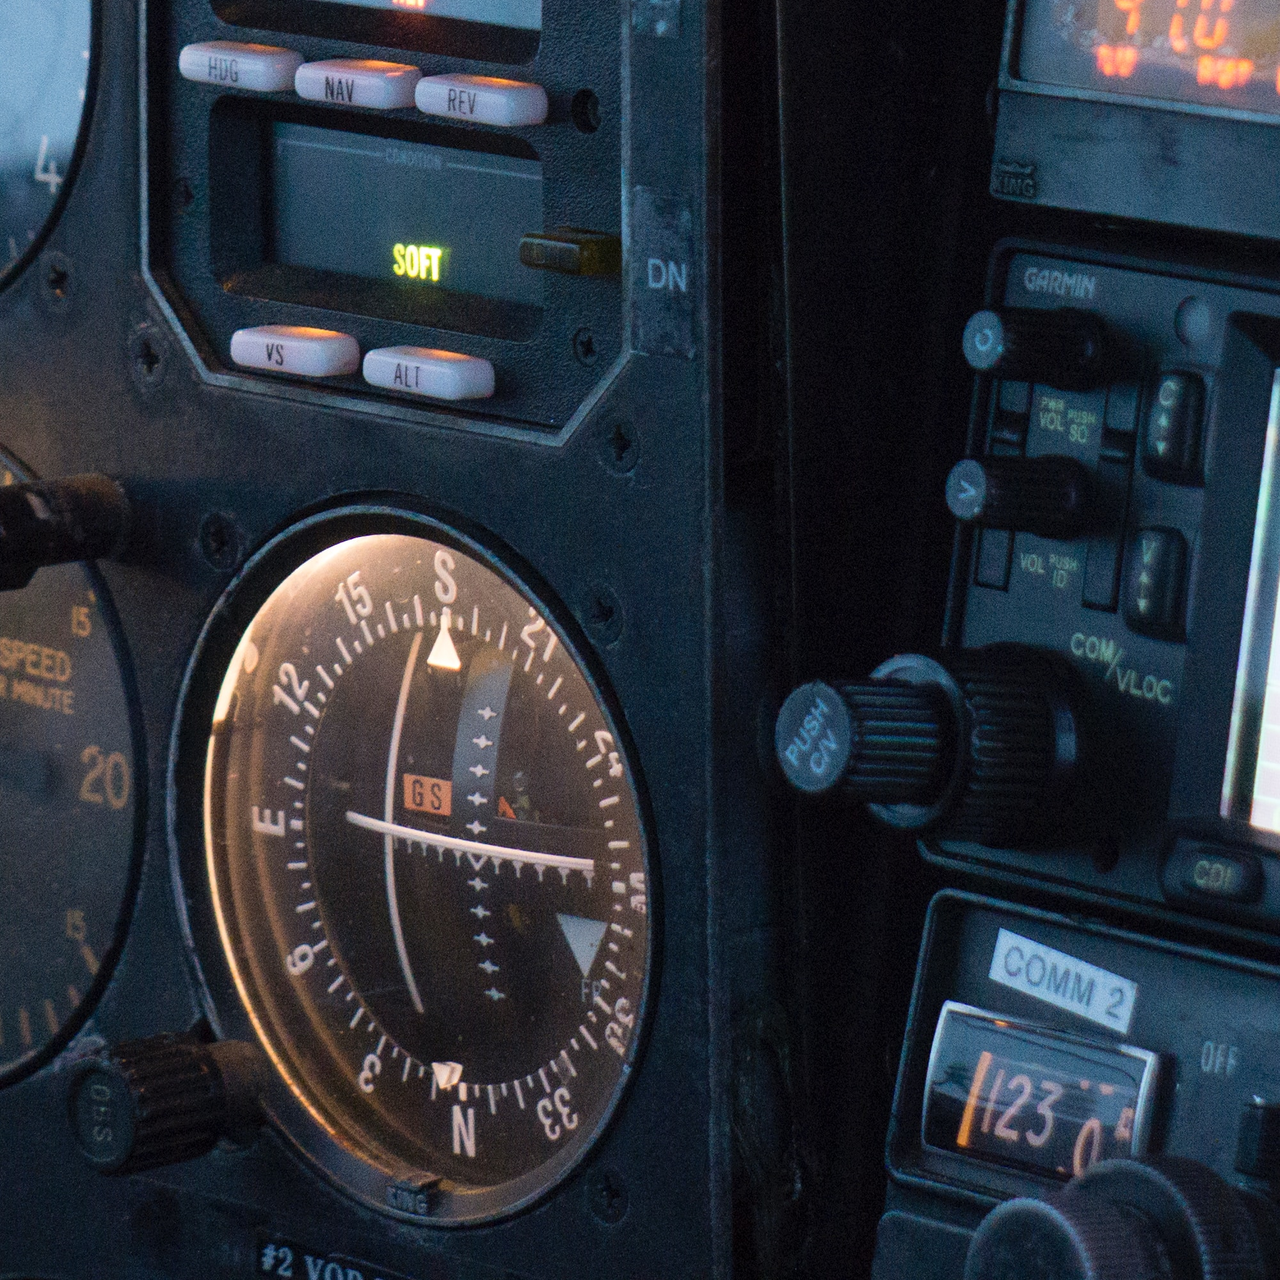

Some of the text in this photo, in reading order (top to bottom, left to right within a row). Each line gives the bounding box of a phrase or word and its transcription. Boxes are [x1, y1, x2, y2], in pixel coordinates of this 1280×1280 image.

[208, 55, 239, 84] HDG
[324, 77, 355, 103] NAV
[447, 88, 477, 116] REV
[34, 134, 63, 194] 4
[392, 242, 443, 282] SOFT
[646, 258, 689, 293] DN
[1023, 266, 1096, 300] GARMIN
[264, 342, 285, 368] VS
[393, 361, 421, 389] ALT
[1157, 380, 1179, 408] C
[434, 549, 457, 606] S
[335, 570, 375, 627] 15
[520, 606, 560, 663] 21
[272, 662, 312, 715] 12
[784, 696, 830, 767] PUSH
[79, 744, 131, 810] 20
[251, 805, 289, 838] E
[1002, 944, 1128, 1021] COMM 2
[357, 1052, 383, 1095] 3
[1200, 1040, 1239, 1077] OFF
[451, 1108, 478, 1158] N
[536, 1086, 579, 1142] 33
[261, 1243, 294, 1278] #2
